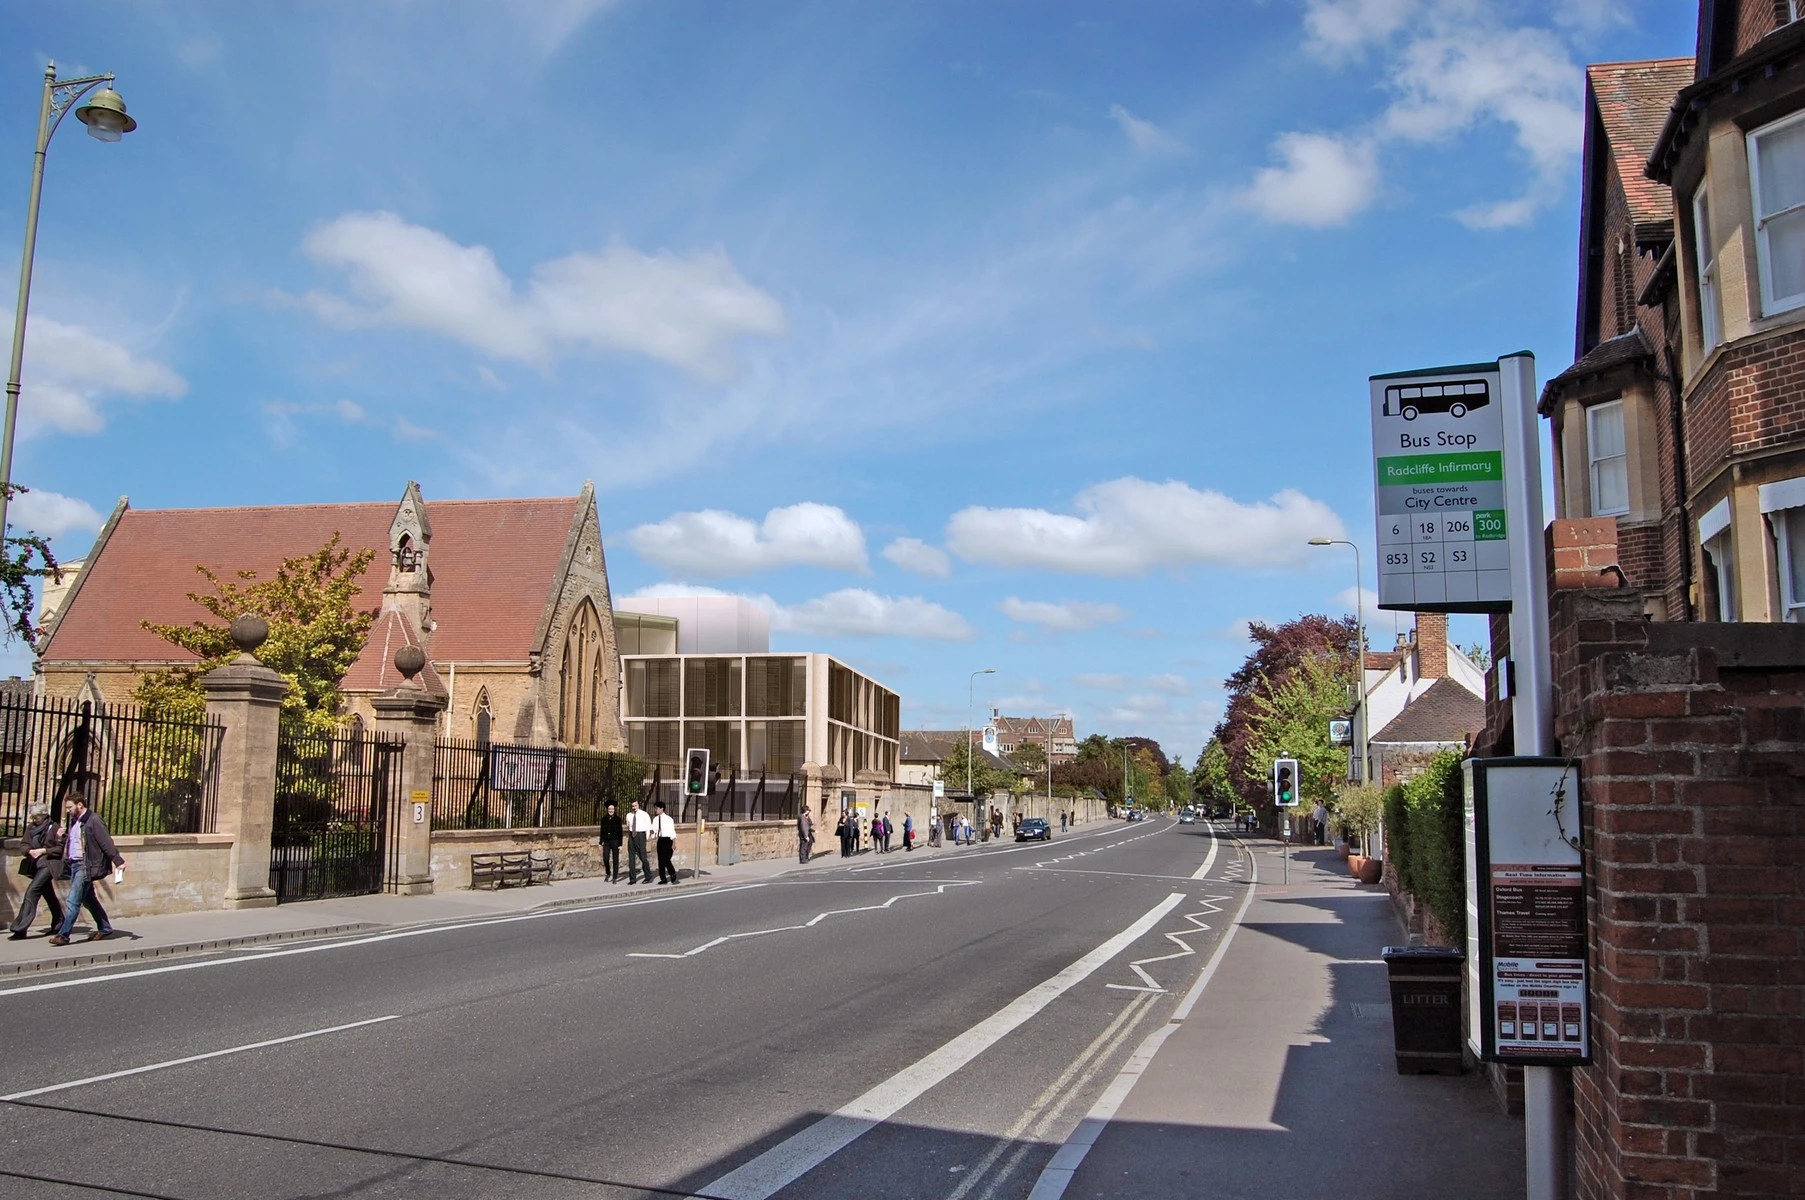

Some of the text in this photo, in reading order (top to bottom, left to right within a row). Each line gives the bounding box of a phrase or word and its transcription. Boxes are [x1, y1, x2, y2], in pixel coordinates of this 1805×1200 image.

[1400, 431, 1477, 449] Bus Stop
[1387, 461, 1491, 476] Radcliffe Infirmary
[1412, 485, 1468, 495] buses towards
[1405, 495, 1477, 510] City Centre
[1475, 512, 1491, 520] park
[1392, 524, 1400, 535] 6
[1420, 522, 1434, 534] 18
[1447, 521, 1470, 532] 206
[1479, 519, 1501, 531] 300
[1386, 553, 1409, 565] 853
[1421, 551, 1436, 564] S2
[1452, 550, 1467, 562] S3
[416, 805, 422, 821] 3
[1403, 994, 1449, 1005] LITTER
